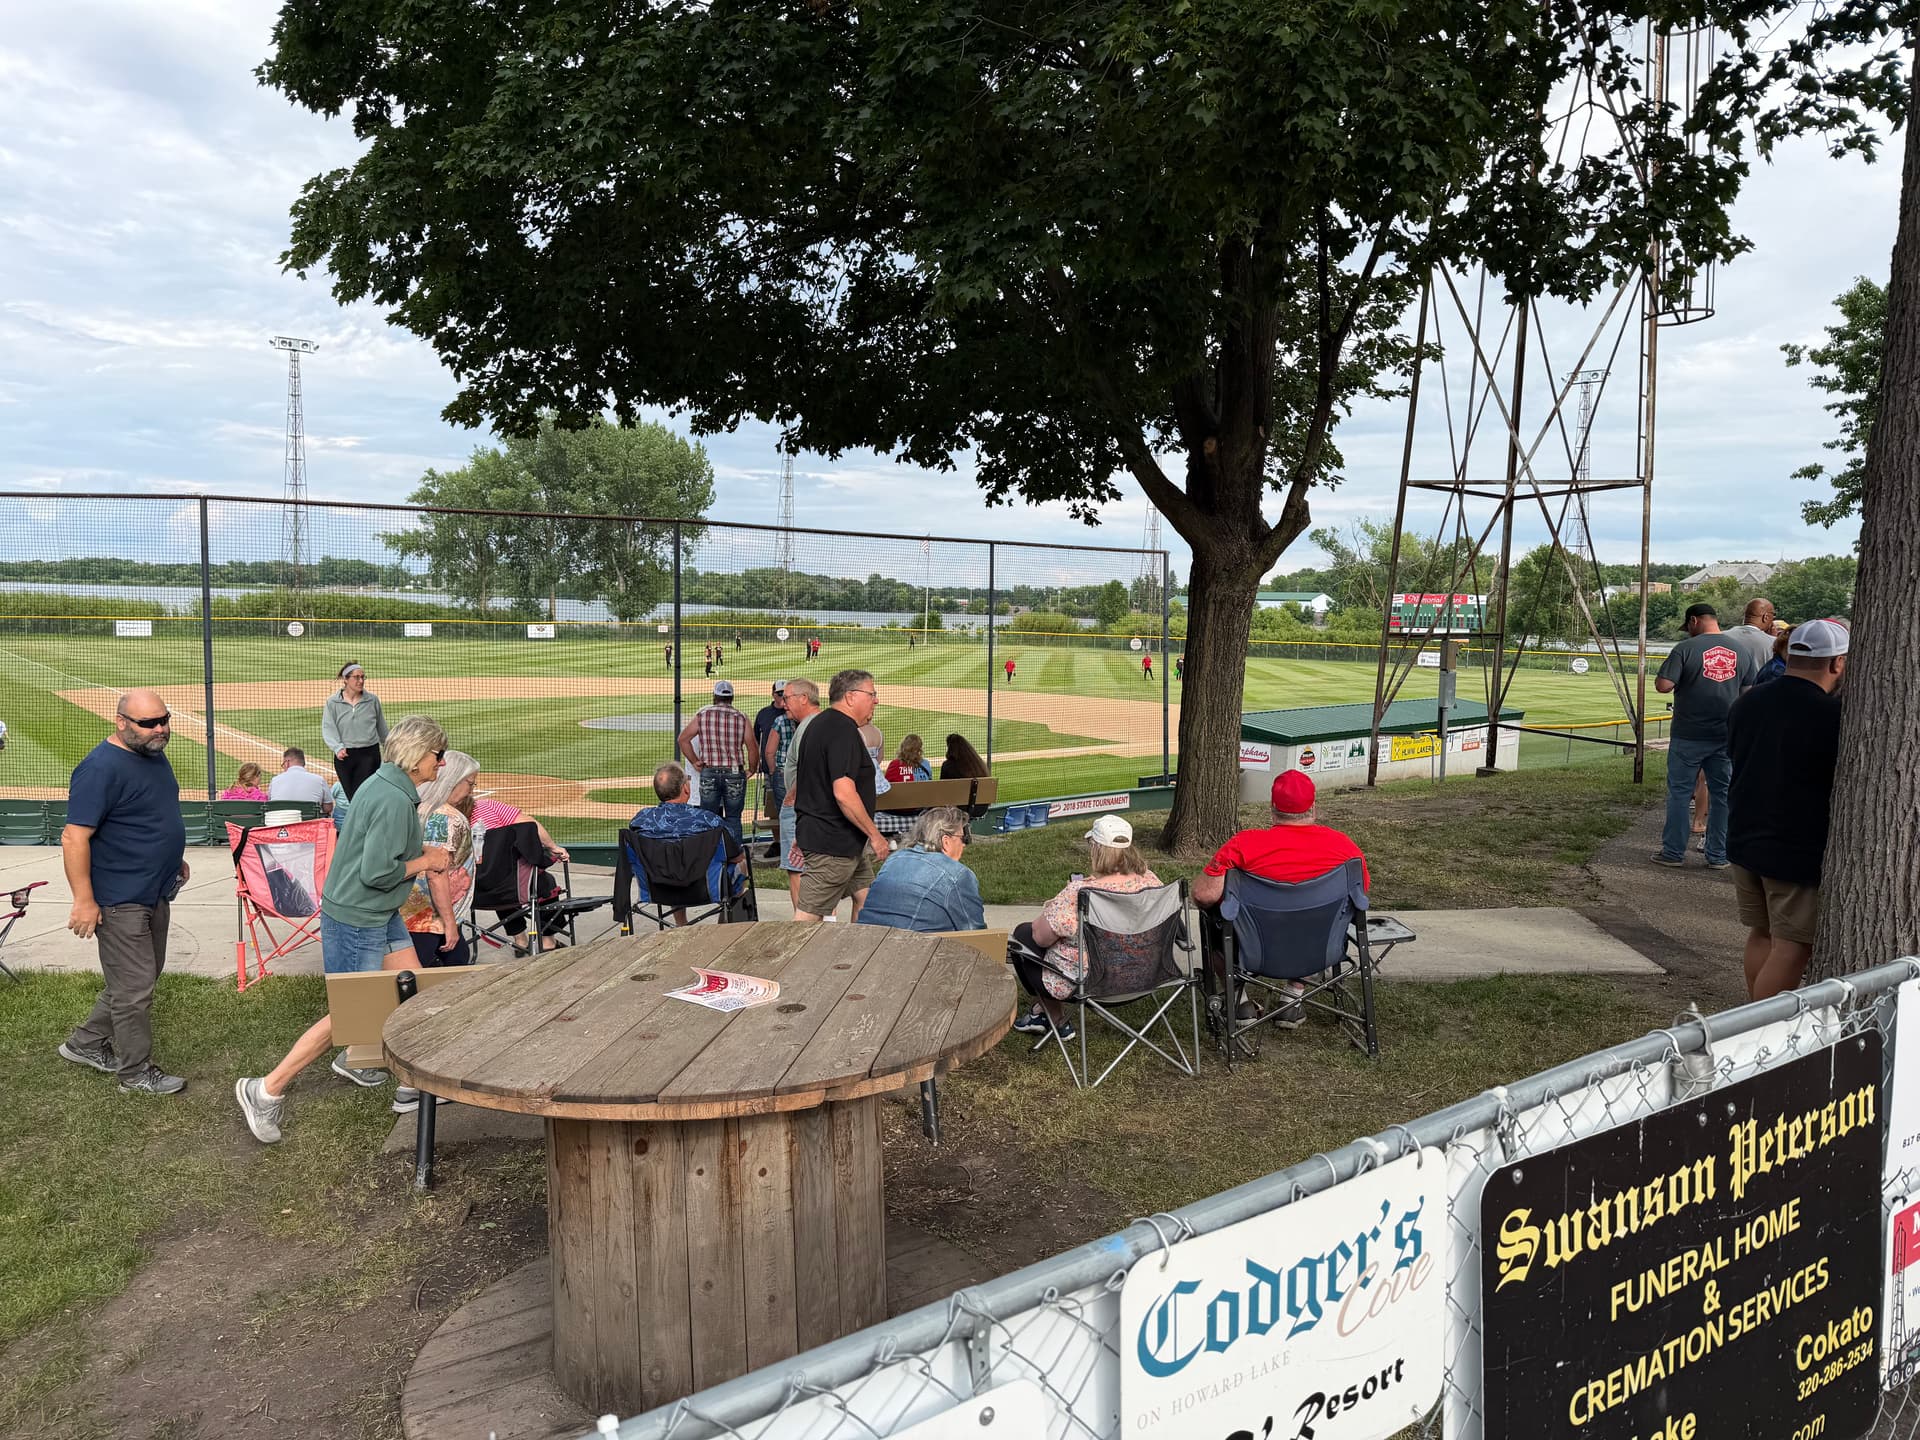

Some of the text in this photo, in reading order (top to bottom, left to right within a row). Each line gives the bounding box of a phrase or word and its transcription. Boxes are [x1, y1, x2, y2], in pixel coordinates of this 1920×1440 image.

[1240, 746, 1269, 758] rphans
[1077, 800, 1092, 810] STATE
[1093, 796, 1129, 808] TOURNAMENT
[1495, 1083, 1876, 1292] Swanson Peterson
[1137, 1195, 1425, 1378] Codger's
[1336, 1252, 1434, 1338] Cove
[1610, 1197, 1801, 1322] FUNERAL HOME
[1702, 1280, 1721, 1315] &
[1569, 1257, 1830, 1427] CREMATION SERVICES
[1796, 1306, 1873, 1371] Cokato
[1797, 1337, 1874, 1401] 320-286-2534
[1136, 1350, 1291, 1431] ON HOWARD LAKE
[1289, 1357, 1405, 1440] Resort
